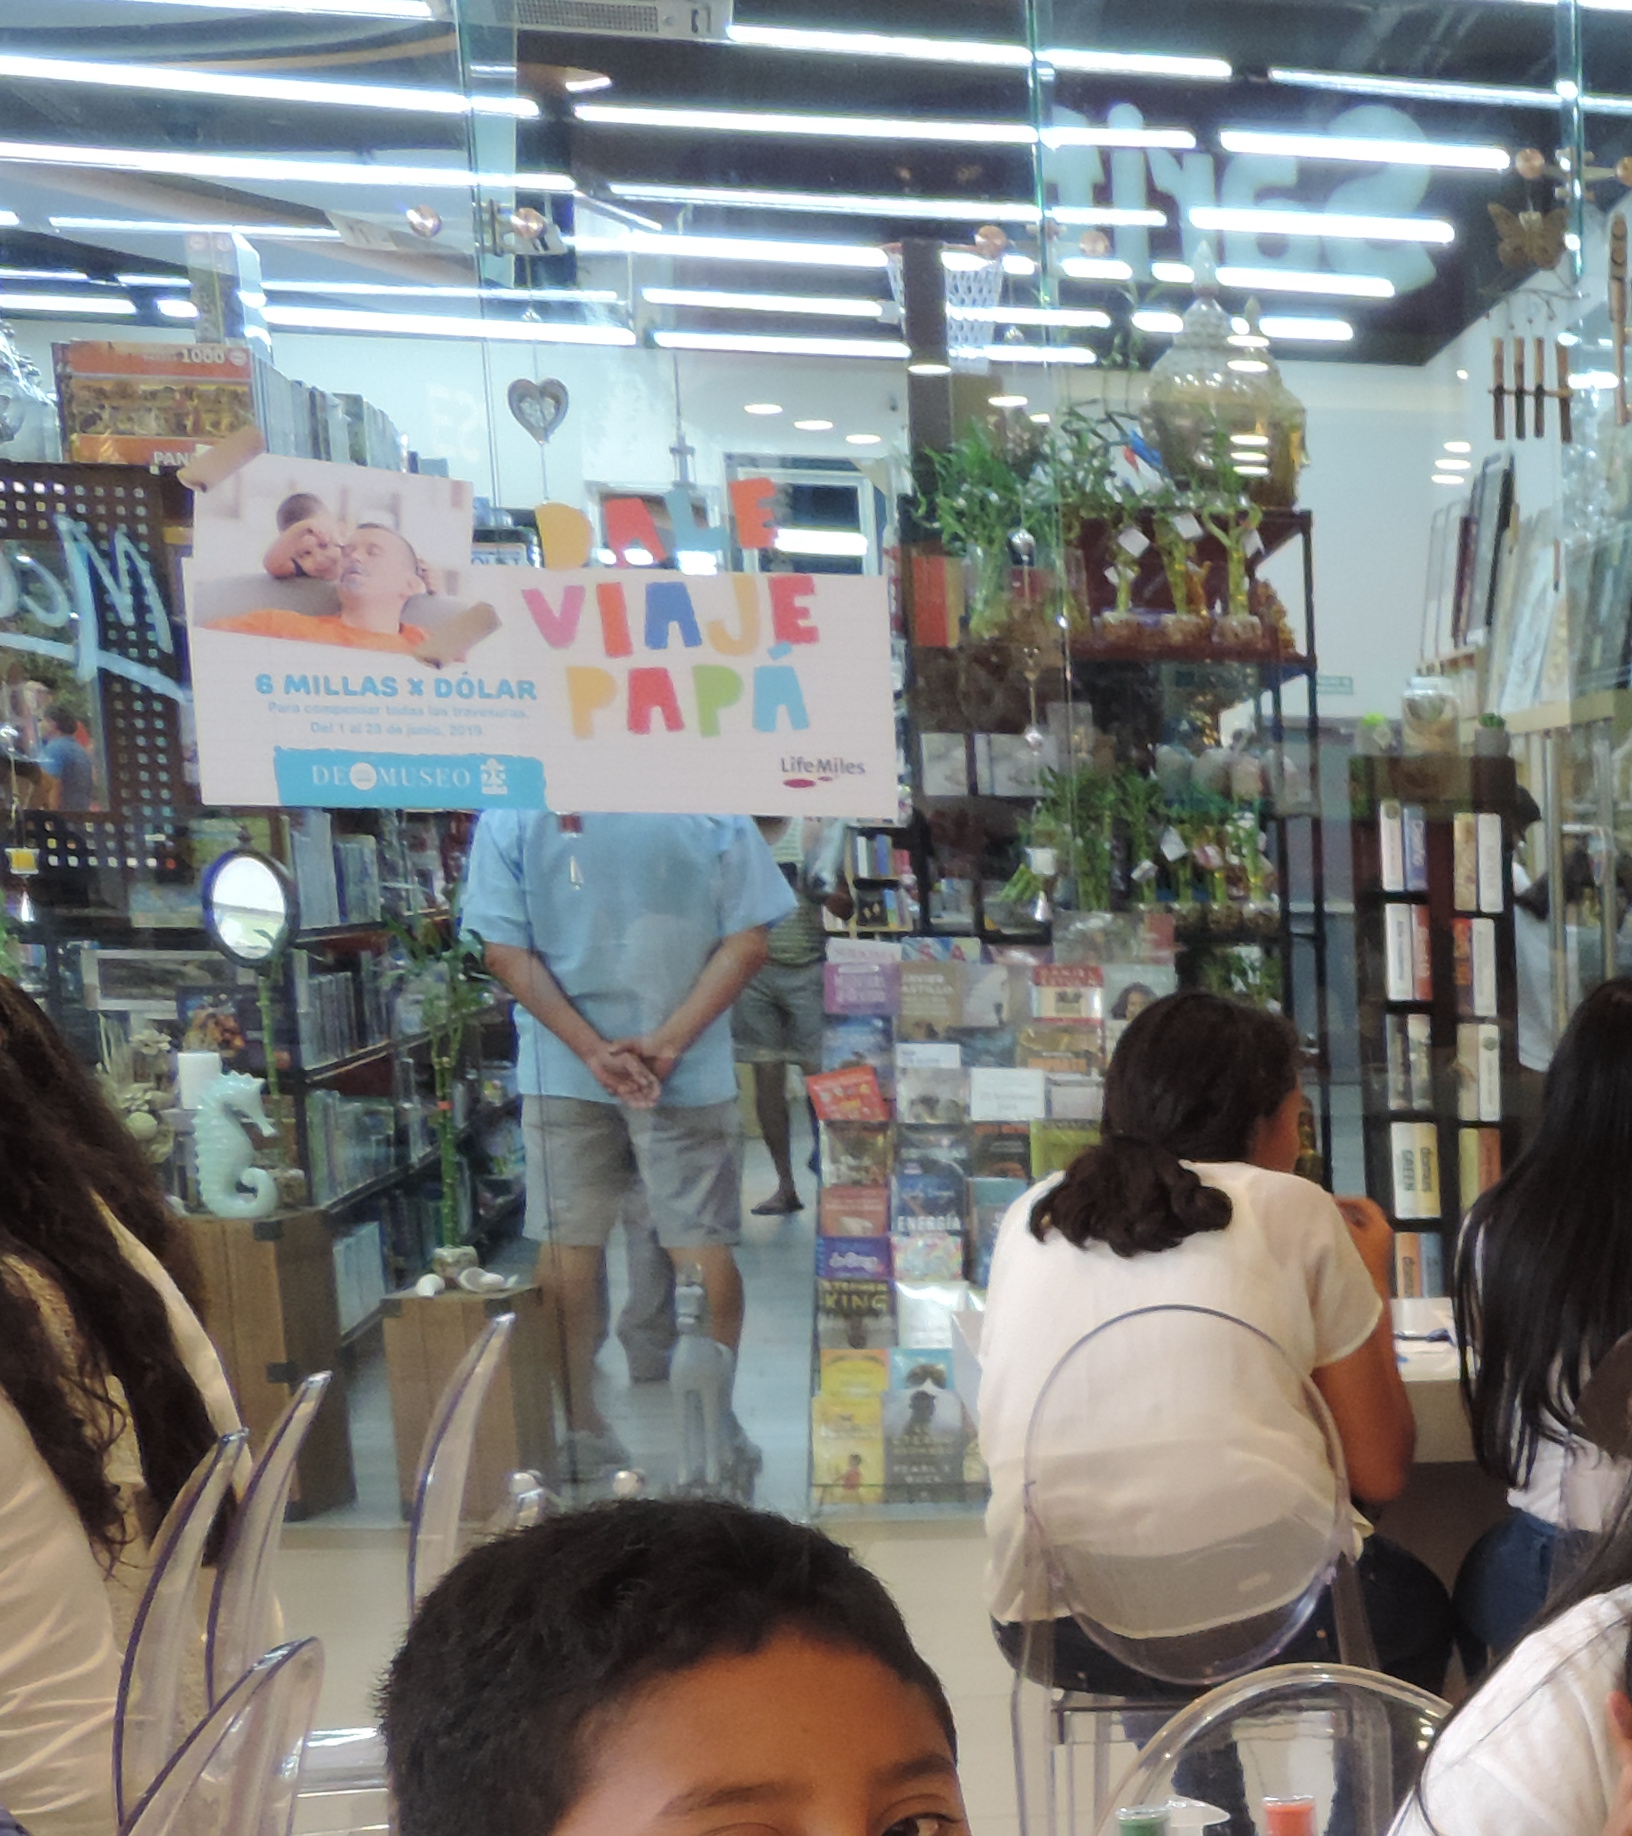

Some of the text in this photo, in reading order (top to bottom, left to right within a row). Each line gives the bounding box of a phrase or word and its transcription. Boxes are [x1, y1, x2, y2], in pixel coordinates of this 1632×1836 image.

[181, 348, 226, 365] 1000
[535, 477, 777, 570] DALE
[521, 574, 819, 658] VIAJE
[254, 673, 274, 695] 6
[284, 674, 399, 697] MILLAS
[434, 671, 538, 700] DÓLAR
[565, 641, 810, 741] PAPÁ
[268, 701, 300, 714] Para
[304, 703, 380, 718] compensar
[310, 721, 334, 733] Del
[376, 765, 472, 788] MUSEO
[780, 757, 866, 776] LifeMiles
[824, 1294, 889, 1312] KING
